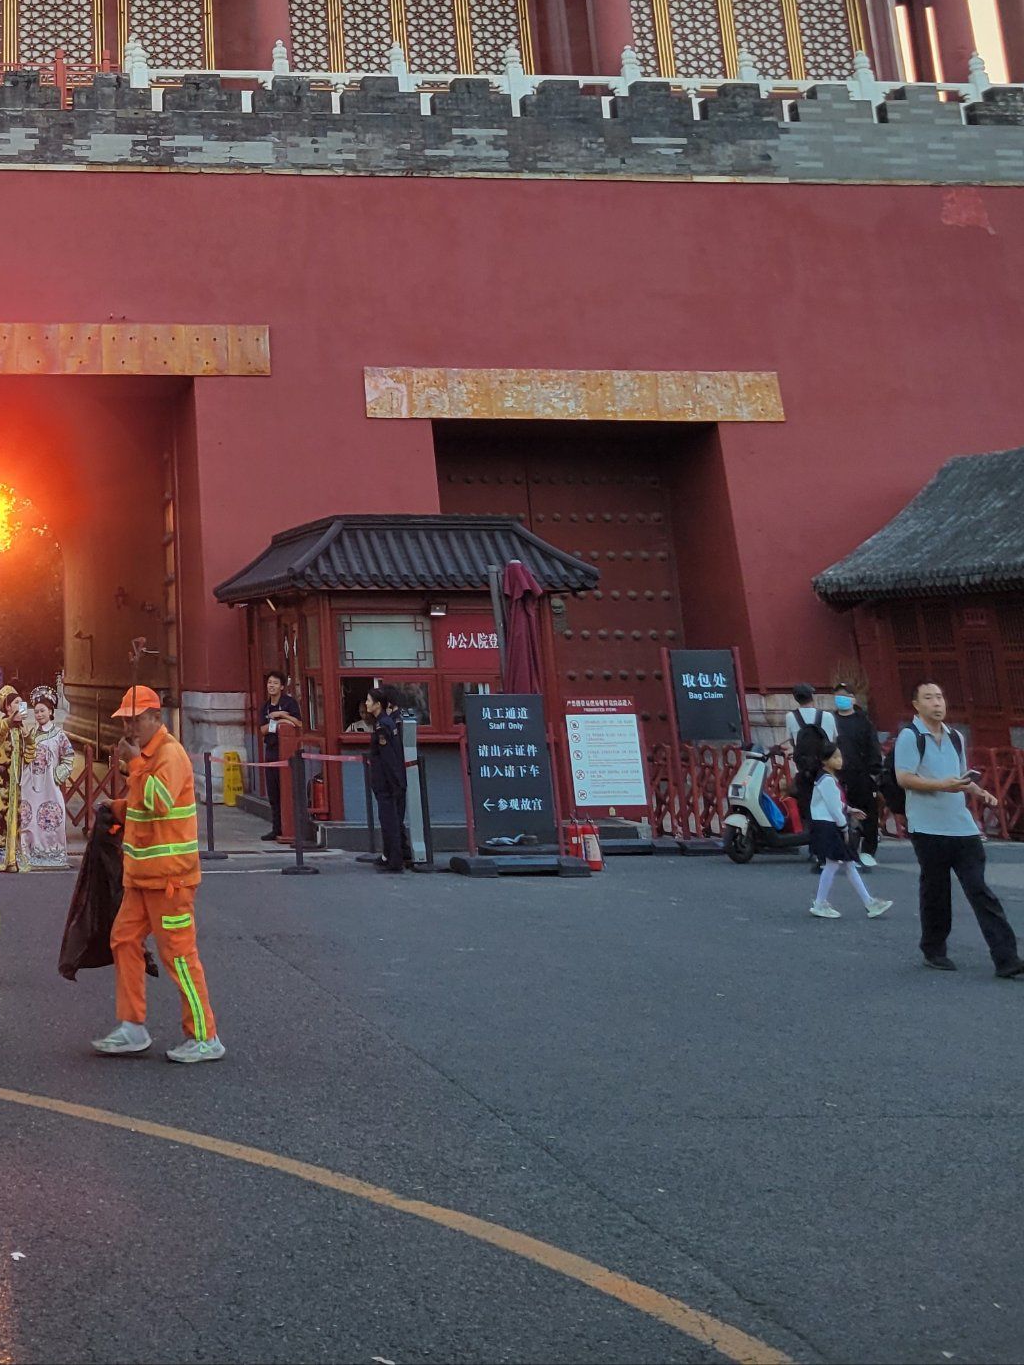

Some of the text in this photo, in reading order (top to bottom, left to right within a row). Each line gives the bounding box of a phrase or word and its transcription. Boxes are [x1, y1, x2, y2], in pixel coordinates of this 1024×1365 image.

[682, 672, 727, 688] 取包处
[688, 691, 724, 700] Bag Claim
[482, 707, 529, 720] 员工通道
[489, 722, 524, 731] Staff Only
[478, 744, 538, 757] 请出示证件
[480, 764, 540, 778] 出入请下车
[498, 798, 543, 811] 参观故宫
